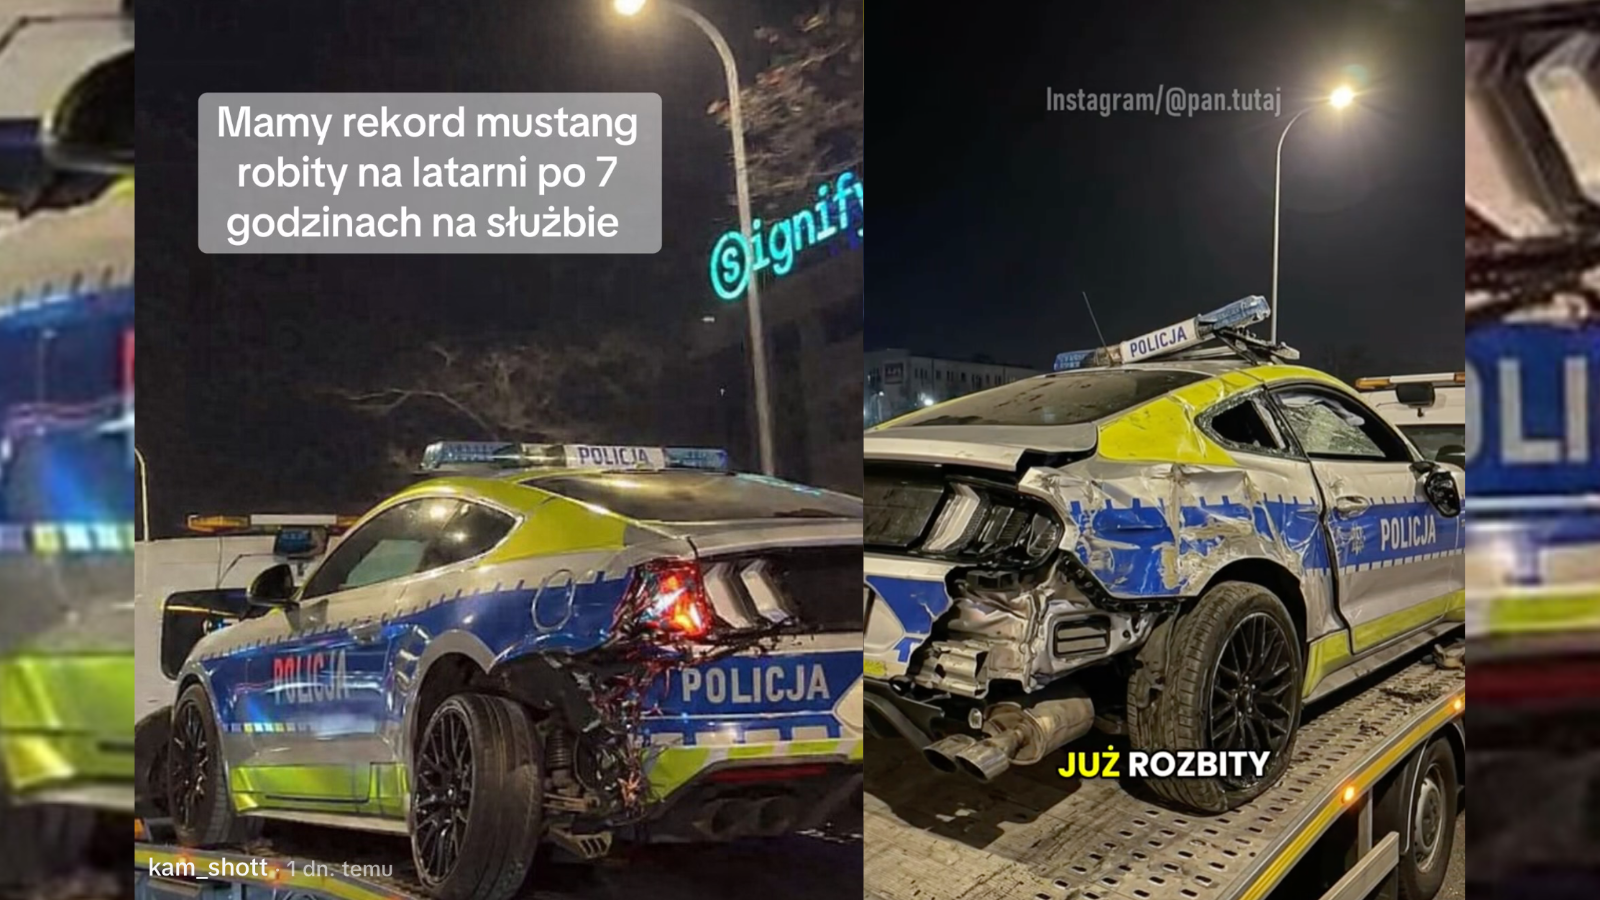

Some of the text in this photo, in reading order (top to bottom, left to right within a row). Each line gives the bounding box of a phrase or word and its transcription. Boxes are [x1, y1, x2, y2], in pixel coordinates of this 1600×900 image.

[1129, 325, 1187, 358] POLICJA
[577, 446, 651, 465] POLICJA
[1380, 514, 1436, 552] POLICJA
[273, 648, 349, 706] POLICJA
[681, 664, 830, 704] POLICJA
